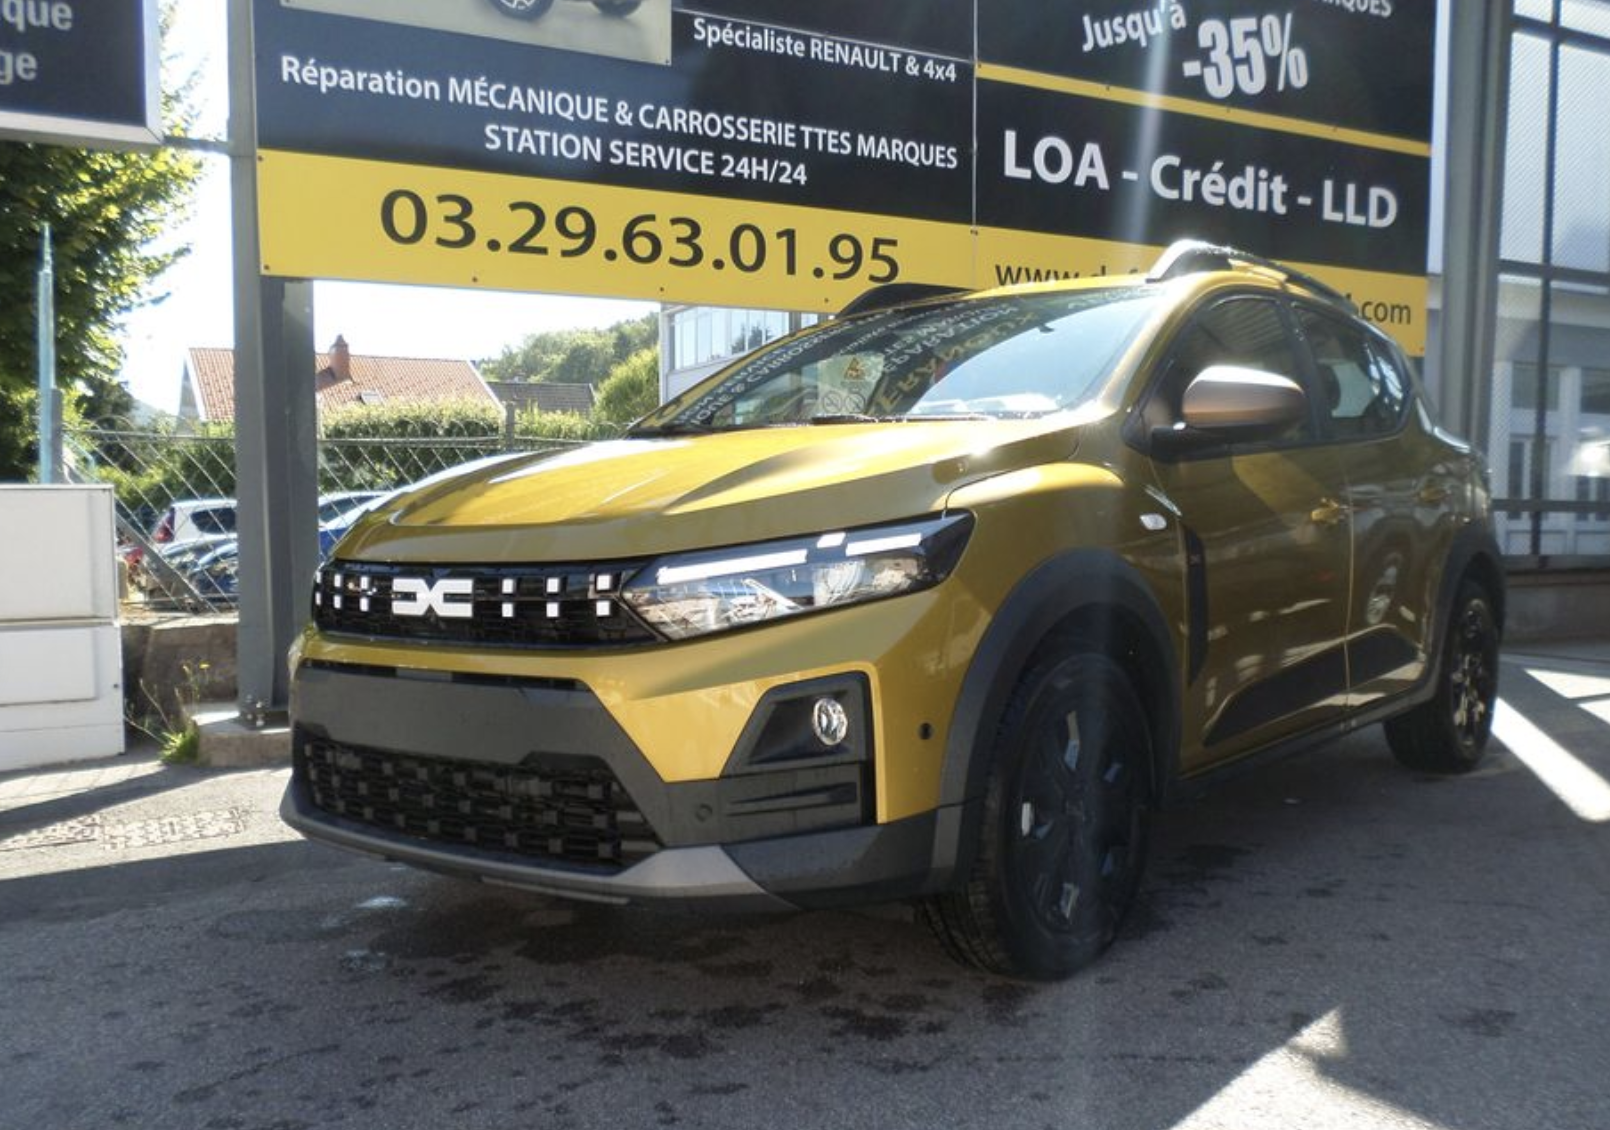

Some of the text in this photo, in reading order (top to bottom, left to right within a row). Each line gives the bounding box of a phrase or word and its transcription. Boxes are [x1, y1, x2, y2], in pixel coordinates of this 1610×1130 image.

[692, 16, 958, 83] Spécialiste RENAULT & 4x4
[1181, 12, 1309, 99] -35%
[280, 55, 959, 170] Réparation MÉCANIQUE & CARROSSERIE TTES MARQUES
[484, 123, 808, 186] STATION SERVICE 24H/24
[1003, 129, 1110, 191] LOA
[1149, 154, 1288, 215] Crédit
[1321, 179, 1398, 228] LLD
[379, 188, 900, 284] 03.29.63.01.95
